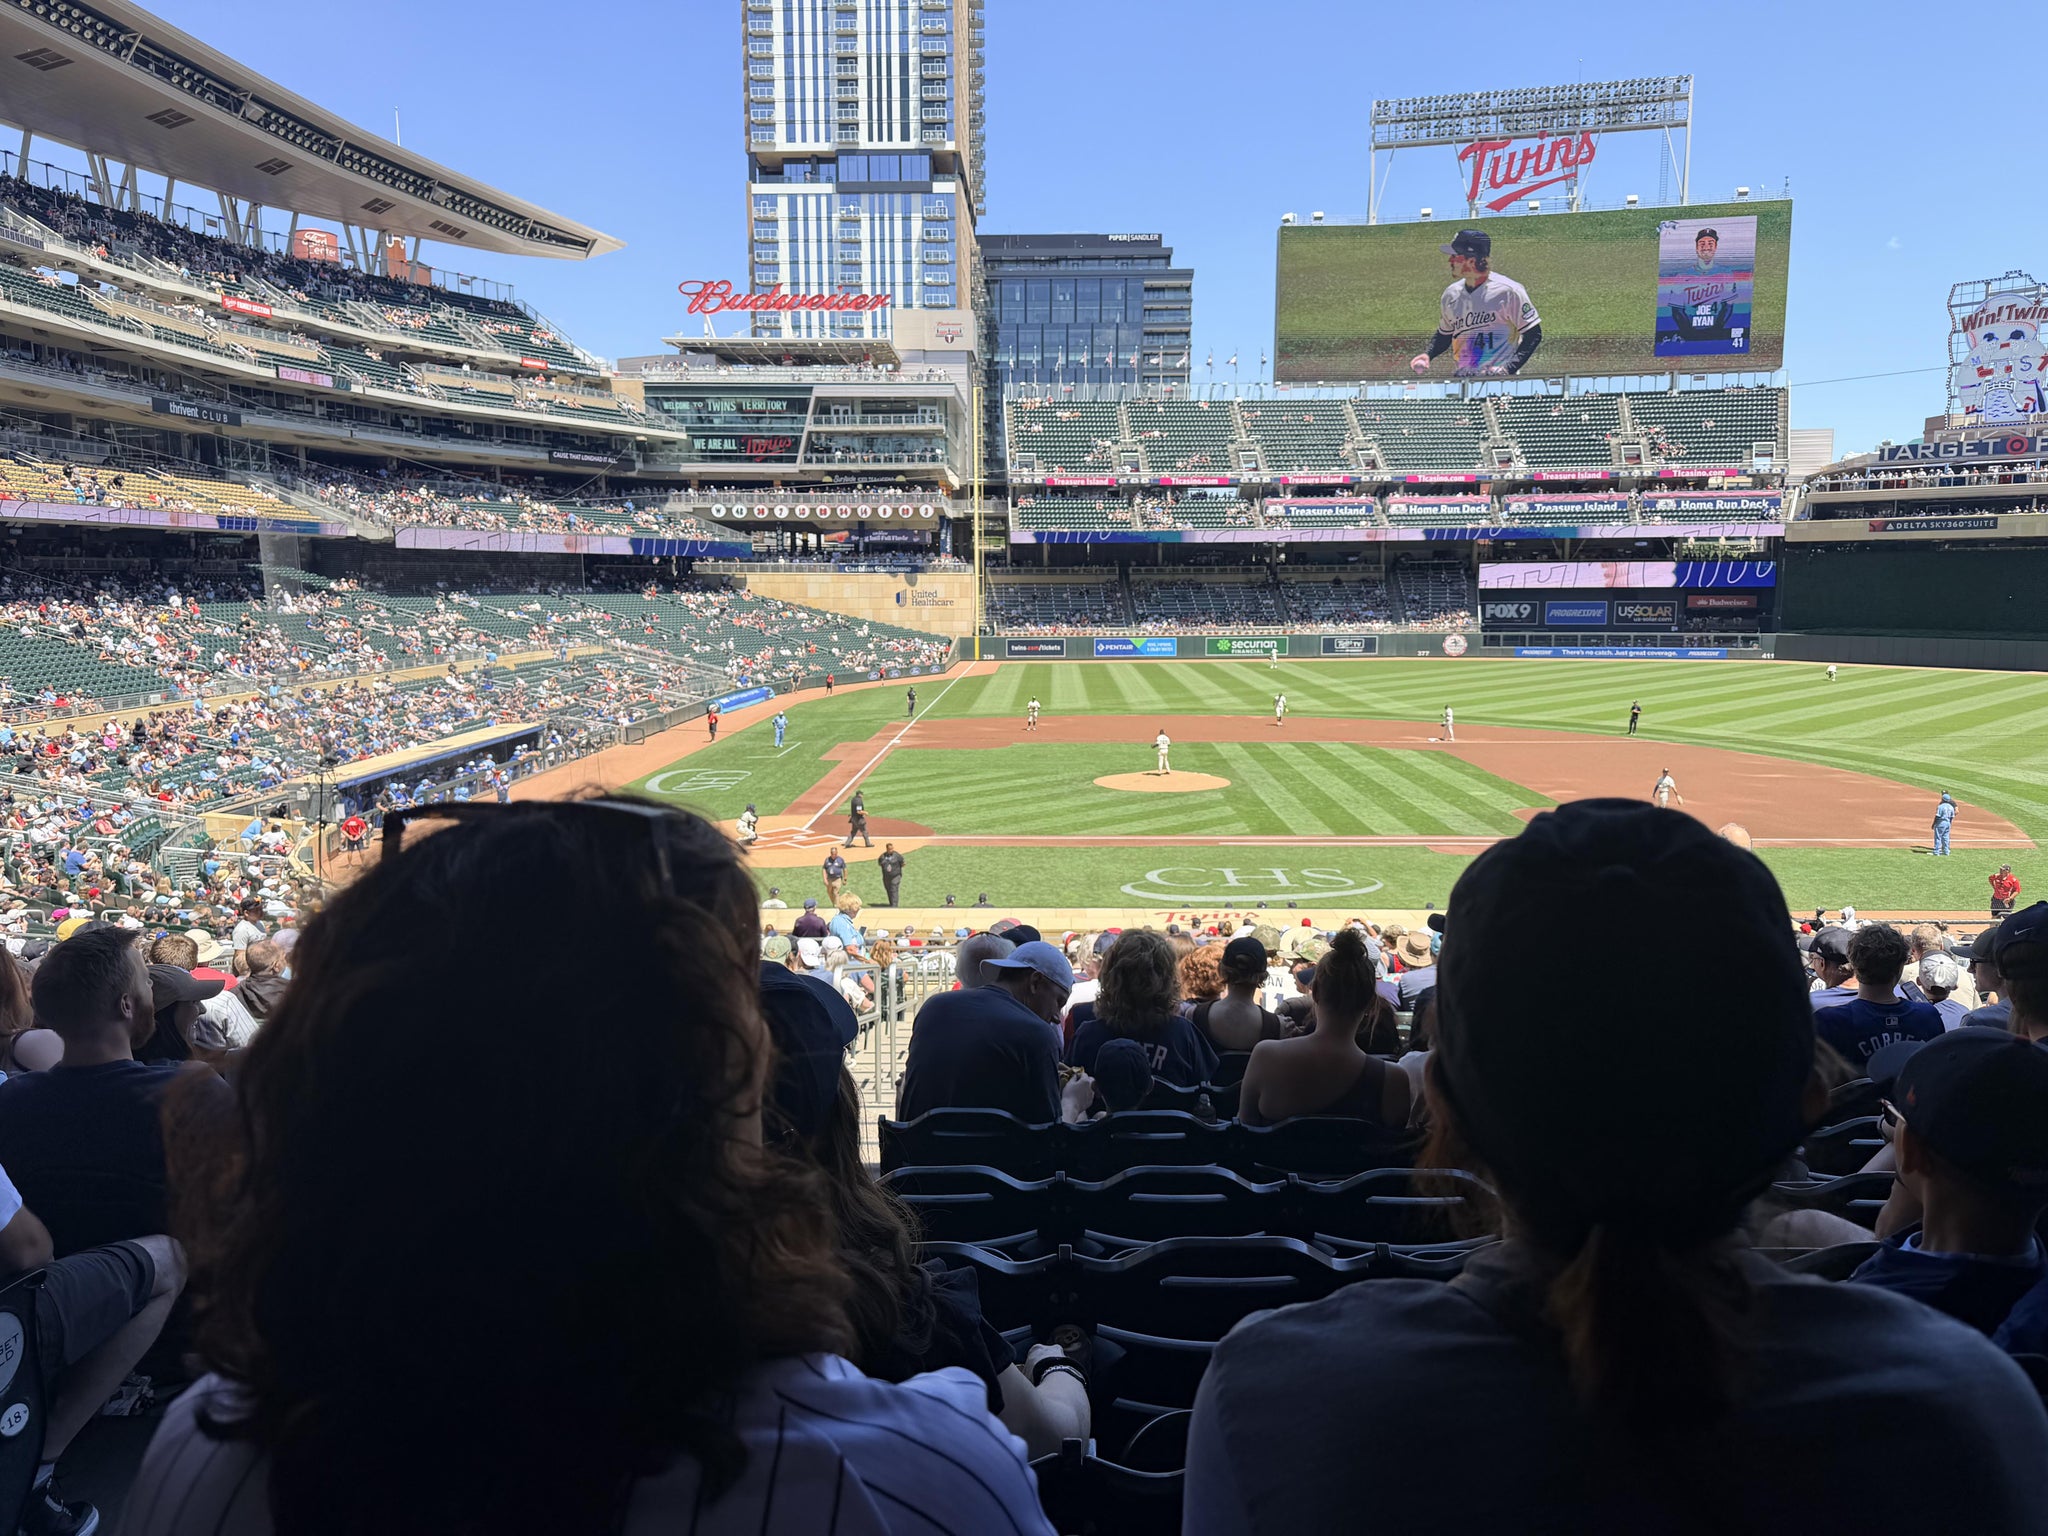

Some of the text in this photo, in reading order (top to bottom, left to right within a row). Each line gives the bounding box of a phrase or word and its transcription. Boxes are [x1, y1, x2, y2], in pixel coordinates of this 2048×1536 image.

[1458, 130, 1597, 212] Twins
[678, 280, 891, 314] Budweiser
[1684, 282, 1725, 307] Twins
[1696, 305, 1711, 315] JOE
[1465, 311, 1496, 328] Cities
[1474, 332, 1494, 350] 41
[1732, 338, 1744, 348] 41
[663, 401, 690, 410] WELCOME
[707, 400, 736, 411] TWINS
[742, 400, 788, 410] TERRITORY
[169, 401, 228, 423] thrivent CLUB
[693, 435, 793, 463] WE ARE ALL Twins
[1880, 438, 2001, 461] TARGET
[1542, 471, 1601, 480] Treasure Island
[1409, 504, 1488, 514] Home Run Deck
[1534, 502, 1618, 512] Treasure Island
[1680, 499, 1769, 509] Home Run Deck
[1289, 506, 1366, 516] Treasure Island
[1896, 521, 1928, 529] DELTA
[1968, 519, 1994, 528] SUITE
[911, 590, 937, 598] United
[912, 598, 954, 606] Healthcare
[1485, 604, 1531, 618] FOX 9
[1549, 609, 1604, 617] PROGRESSIVE
[1231, 639, 1277, 649] securian
[1145, 867, 1355, 887] CHS
[7, 1411, 22, 1429] 18
